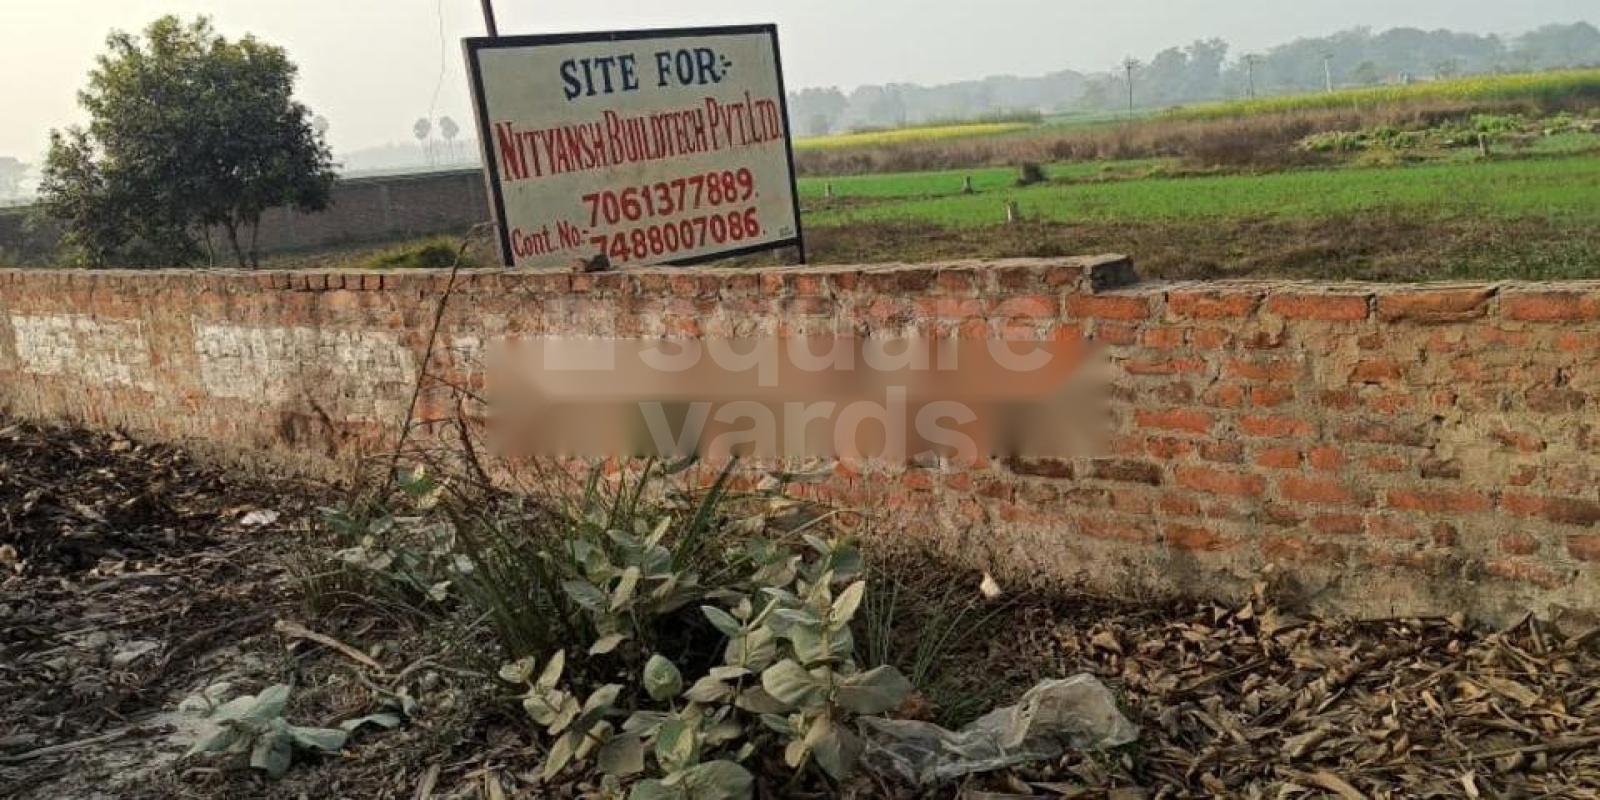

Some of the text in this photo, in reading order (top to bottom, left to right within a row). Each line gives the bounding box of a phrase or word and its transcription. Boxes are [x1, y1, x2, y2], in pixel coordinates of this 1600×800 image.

[560, 53, 639, 101] SITE
[494, 120, 607, 182] NITYANSH
[603, 109, 706, 165] BUILDTECH
